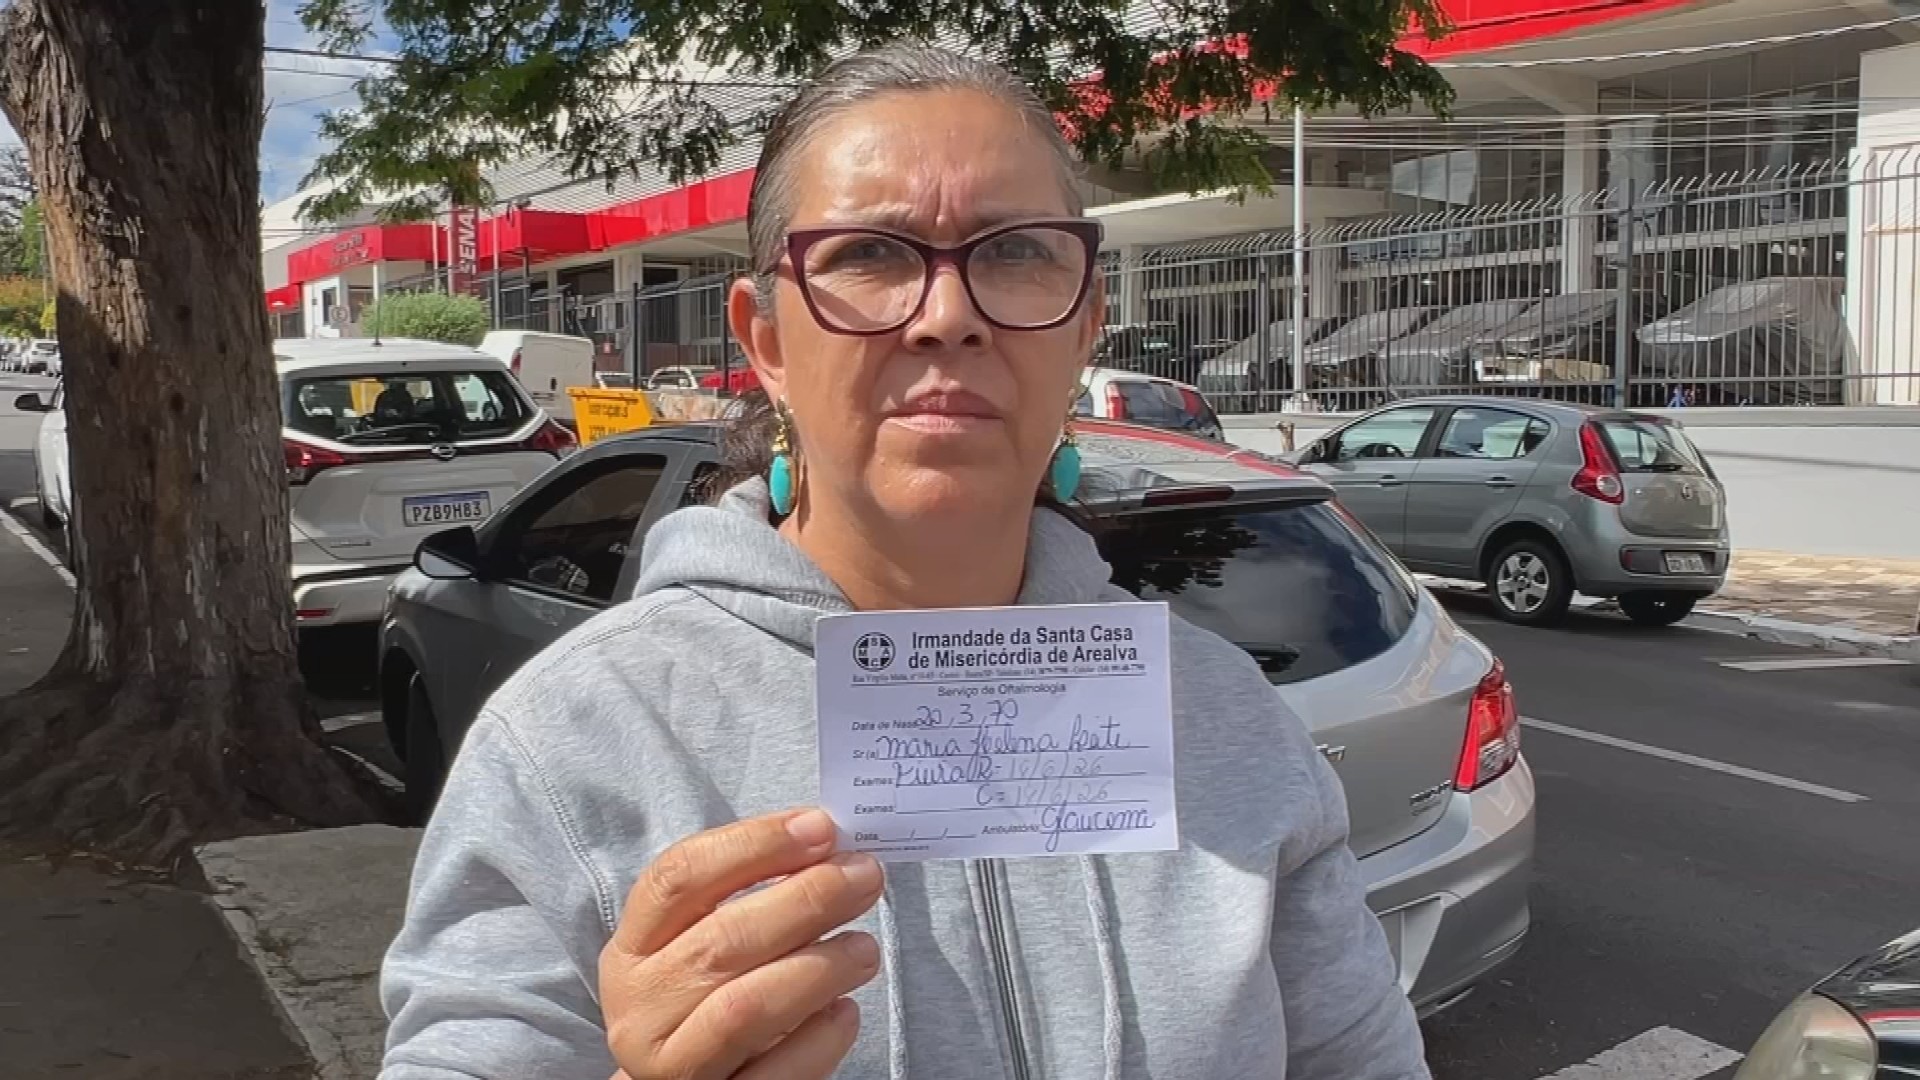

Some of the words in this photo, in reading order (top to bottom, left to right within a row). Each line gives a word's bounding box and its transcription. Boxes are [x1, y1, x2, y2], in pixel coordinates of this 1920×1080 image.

[412, 501, 482, 521] PZB9H83
[912, 628, 1004, 649] Irmandade
[1010, 628, 1031, 645] da
[1036, 626, 1085, 644] Santa
[1090, 624, 1133, 642] Casa
[908, 652, 930, 668] de
[935, 648, 1042, 668] Misericórdia
[1047, 646, 1068, 663] de
[1073, 644, 1137, 662] Arealva
[938, 686, 978, 698] Serviço
[981, 685, 995, 695] de
[998, 682, 1067, 695] Oftalmologia
[852, 721, 875, 731] Data
[878, 720, 890, 730] de
[855, 832, 879, 842] Data
